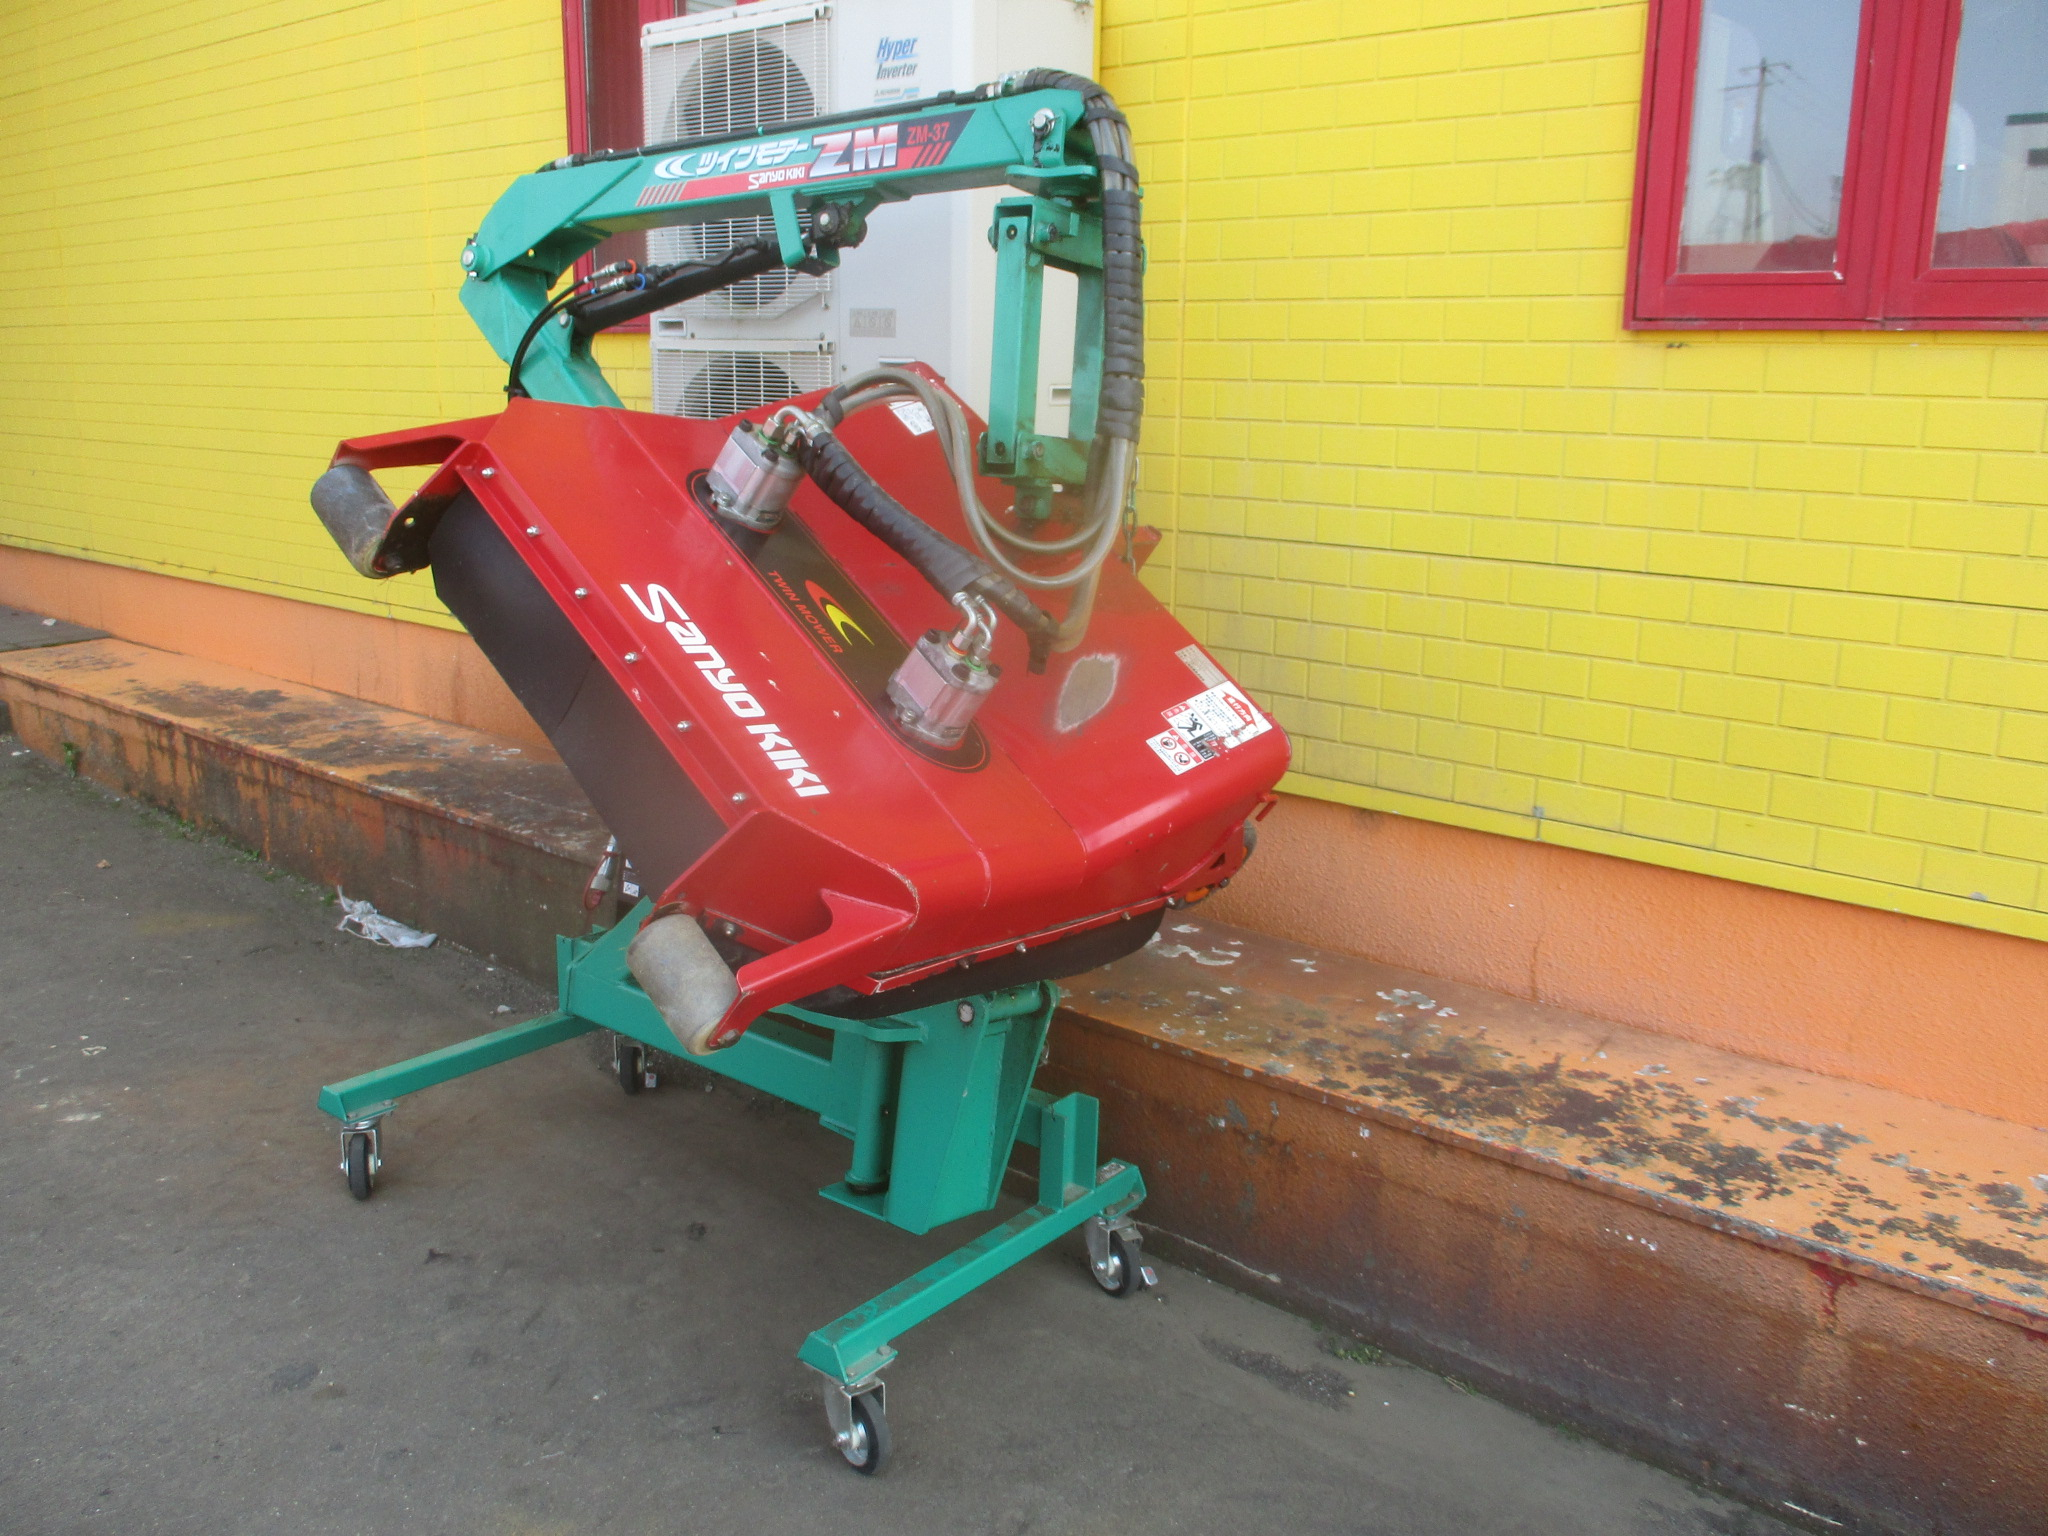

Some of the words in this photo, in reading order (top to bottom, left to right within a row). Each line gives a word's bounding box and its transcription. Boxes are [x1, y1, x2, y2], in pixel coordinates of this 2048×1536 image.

[876, 37, 918, 61] Hyper
[876, 62, 918, 80] Inverter
[809, 124, 899, 179] ZM
[907, 122, 949, 143] ZM-37
[768, 570, 800, 602] TWIN
[795, 603, 843, 653] MOWER
[745, 723, 830, 797] KIKI
